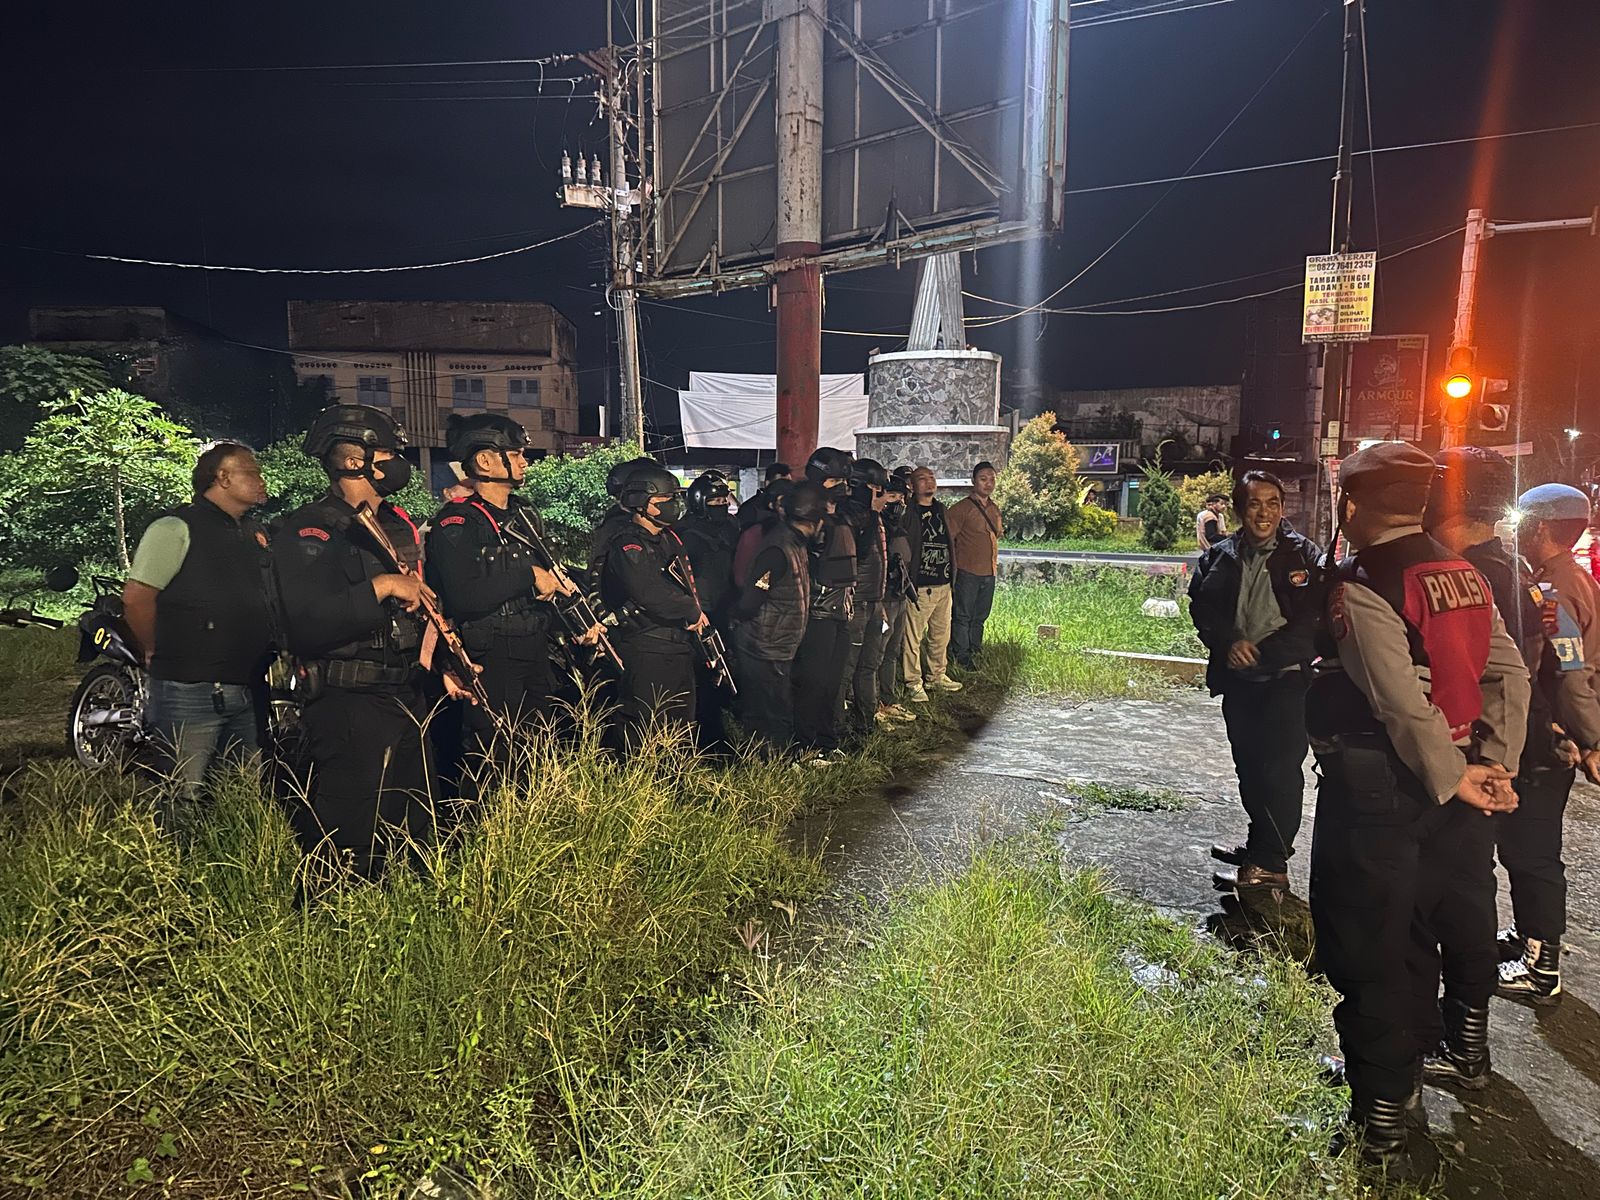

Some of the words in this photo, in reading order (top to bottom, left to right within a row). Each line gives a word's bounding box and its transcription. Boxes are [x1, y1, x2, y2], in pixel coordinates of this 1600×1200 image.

[1343, 253, 1373, 261] TERAPI
[1317, 263, 1335, 271] 0822
[1337, 262, 1353, 270] 7641
[1354, 261, 1373, 269] 2345
[1310, 276, 1341, 284] TAMBAH
[1343, 274, 1370, 282] TINGGI
[1357, 390, 1414, 401] ARMOUR
